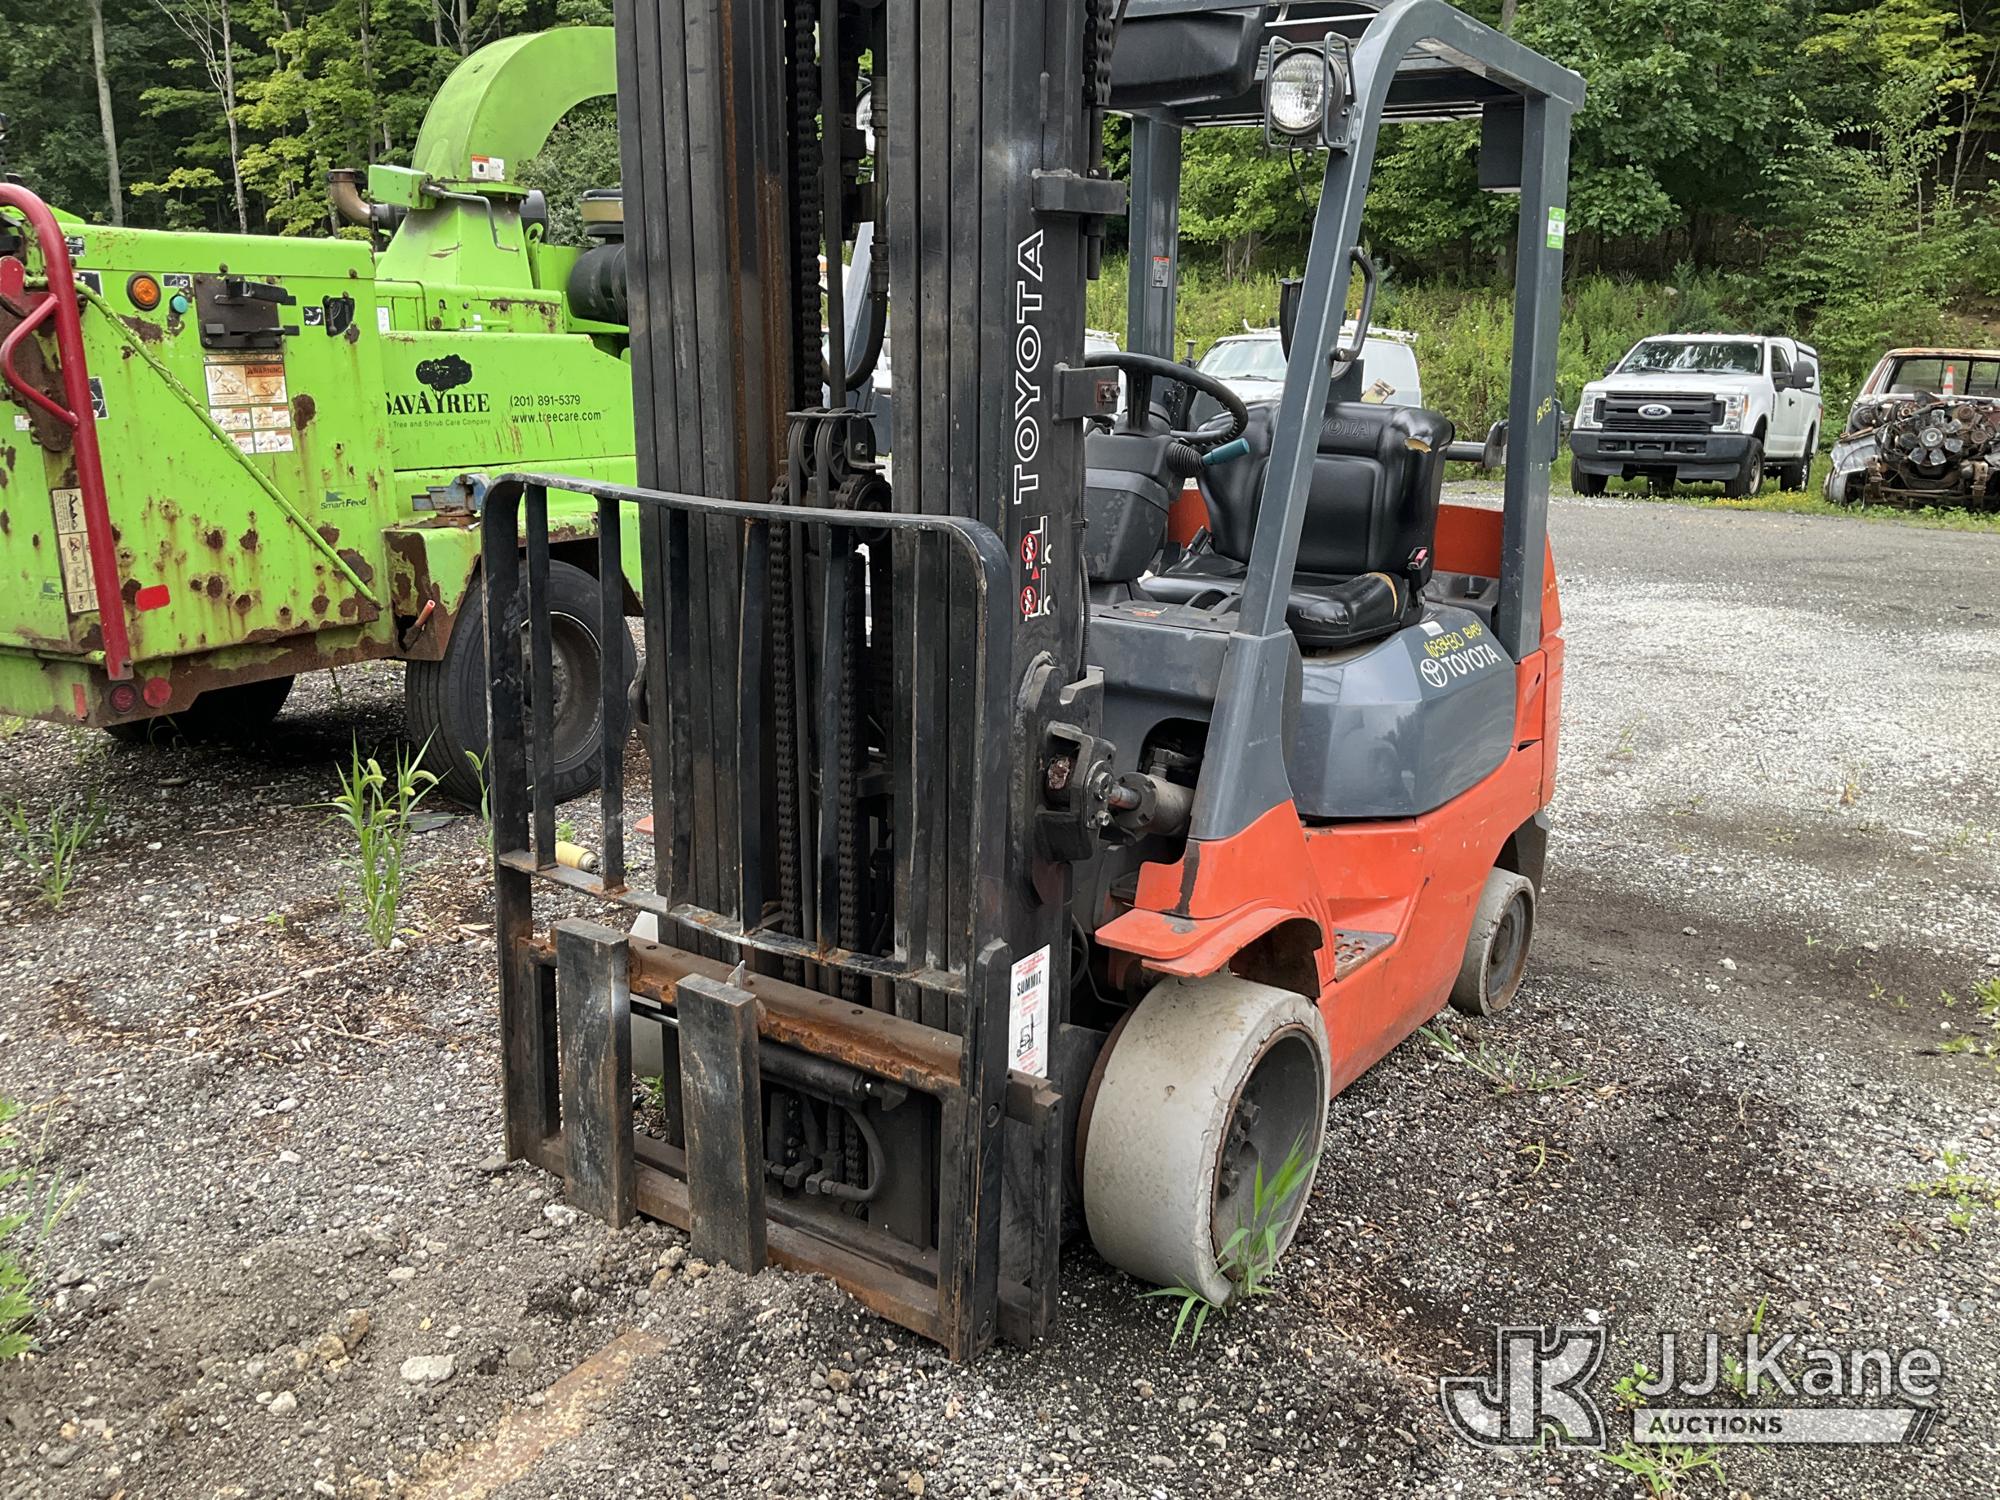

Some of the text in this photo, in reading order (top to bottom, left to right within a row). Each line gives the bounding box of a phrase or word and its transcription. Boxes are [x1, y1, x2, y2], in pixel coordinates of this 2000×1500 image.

[1013, 229, 1044, 505] TOYOTA
[509, 394, 581, 407] (201) 891-5379
[424, 419, 443, 427] Shrub
[462, 418, 491, 427] Company
[511, 411, 602, 424] www.treecare.com
[1440, 643, 1502, 678] TOYOTA
[1017, 970, 1042, 996] SUMMIT
